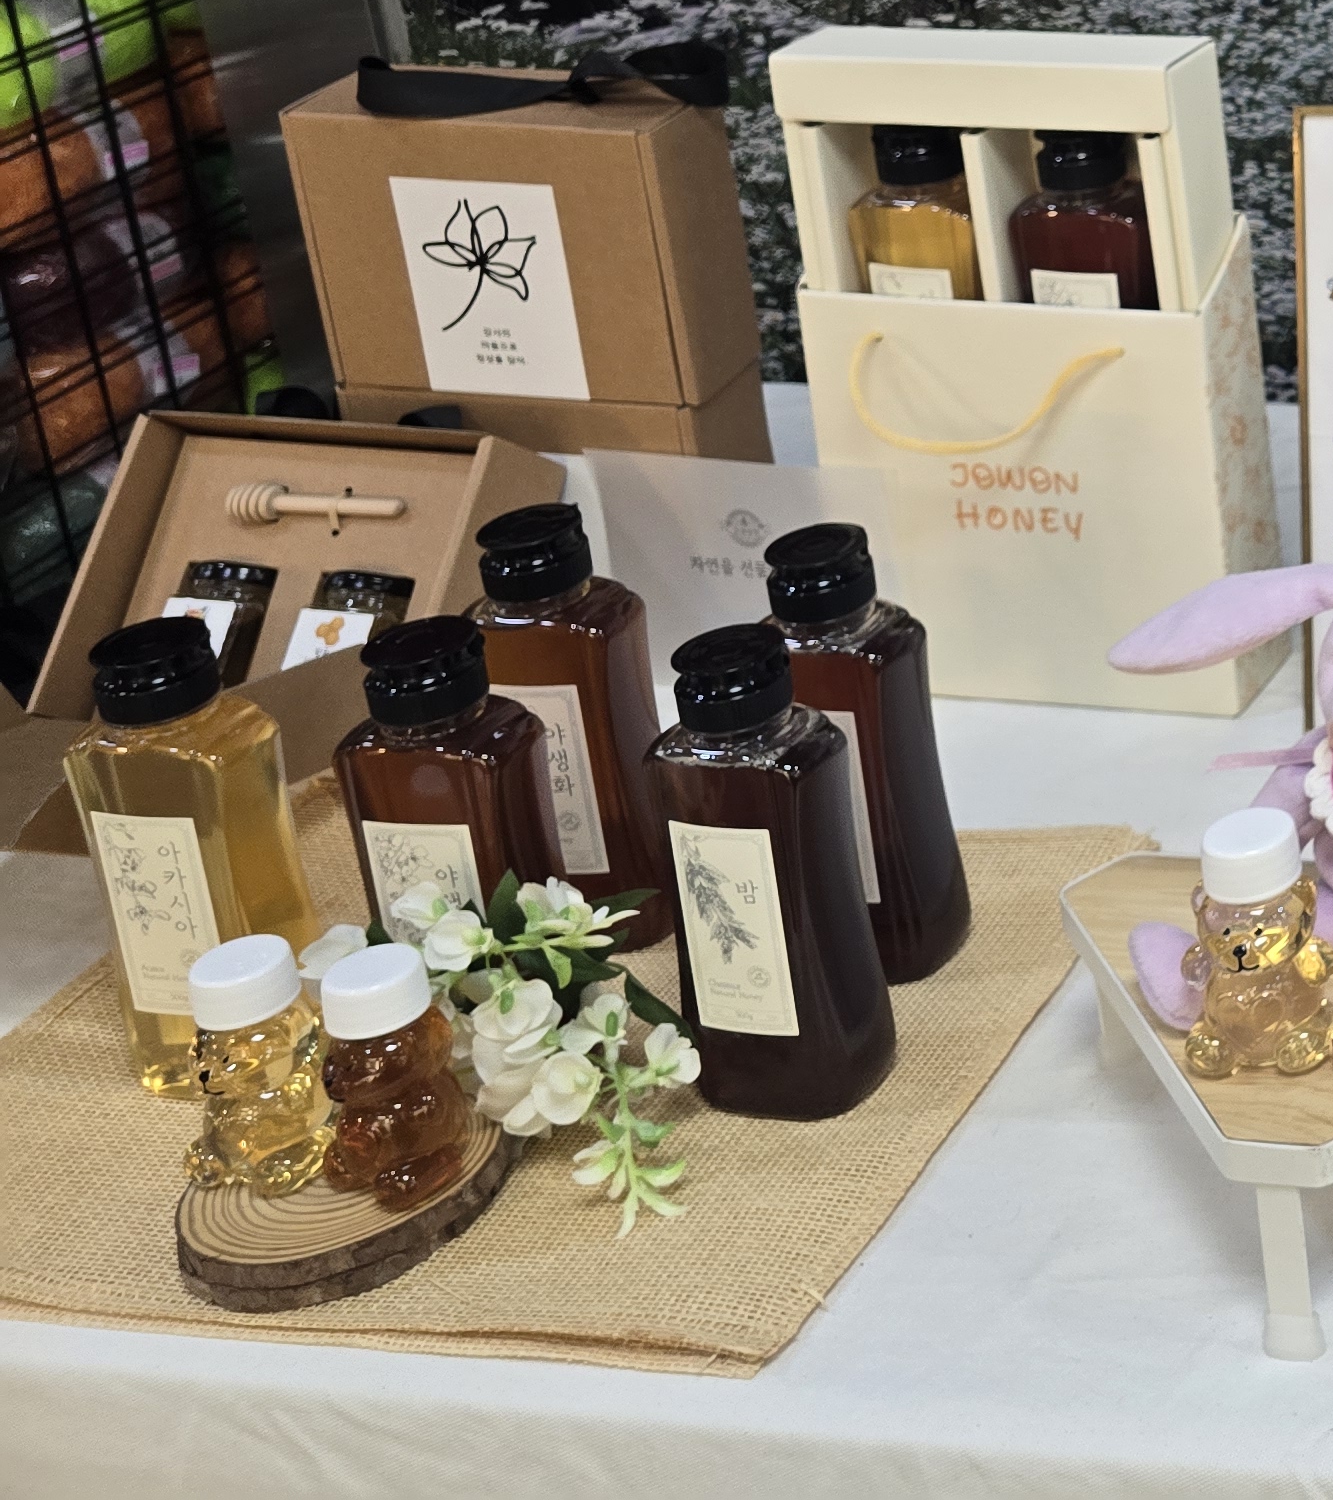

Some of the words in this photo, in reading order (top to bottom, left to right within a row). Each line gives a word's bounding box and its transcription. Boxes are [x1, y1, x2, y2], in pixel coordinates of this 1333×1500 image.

[950, 461, 1080, 496] JOWON
[955, 498, 1085, 542] HONEY
[544, 722, 575, 797] 야생화
[157, 840, 199, 941] 아카시아
[735, 878, 759, 906] 밤
